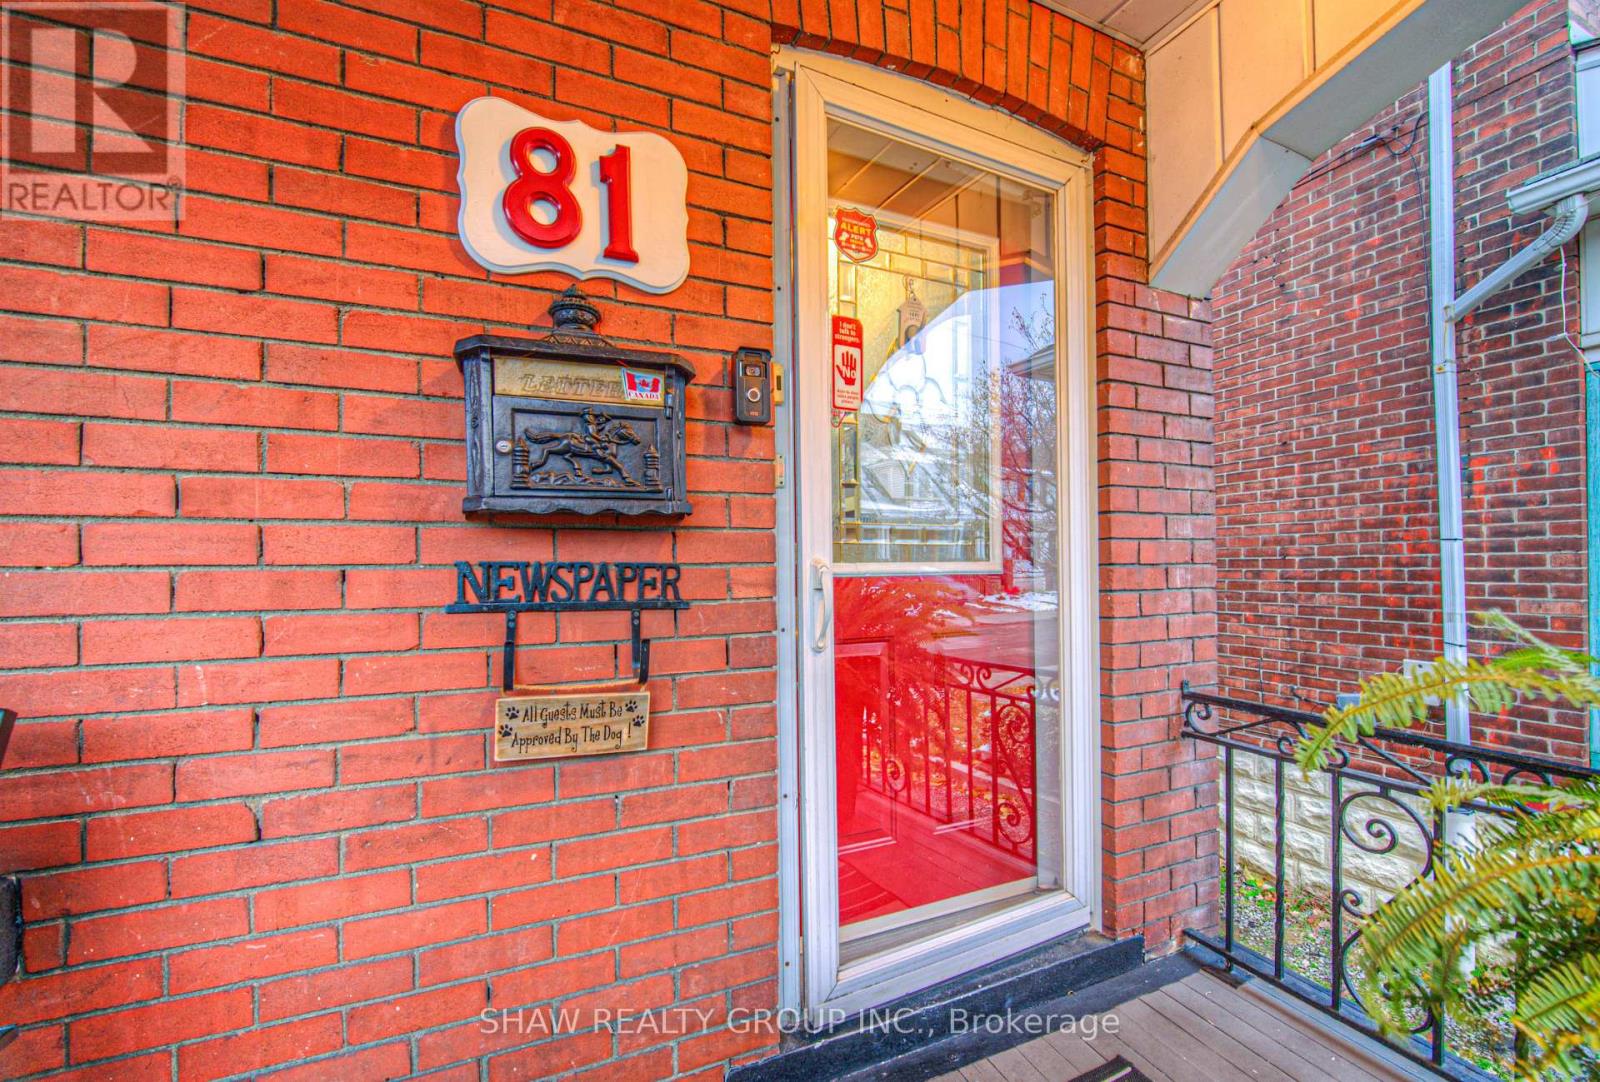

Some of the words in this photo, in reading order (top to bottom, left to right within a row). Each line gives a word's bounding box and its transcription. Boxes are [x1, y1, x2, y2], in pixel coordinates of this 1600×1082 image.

[503, 126, 639, 263] 81
[840, 222, 872, 235] ALERT
[628, 391, 660, 400] CANADA
[454, 560, 683, 604] NEWSPAPER
[522, 705, 538, 723] All
[540, 701, 577, 728] Guests
[579, 700, 607, 719] Must
[609, 701, 623, 718] Be
[511, 726, 561, 753] Approved
[564, 727, 578, 752] By
[581, 725, 601, 743] The
[603, 721, 622, 749] Dog
